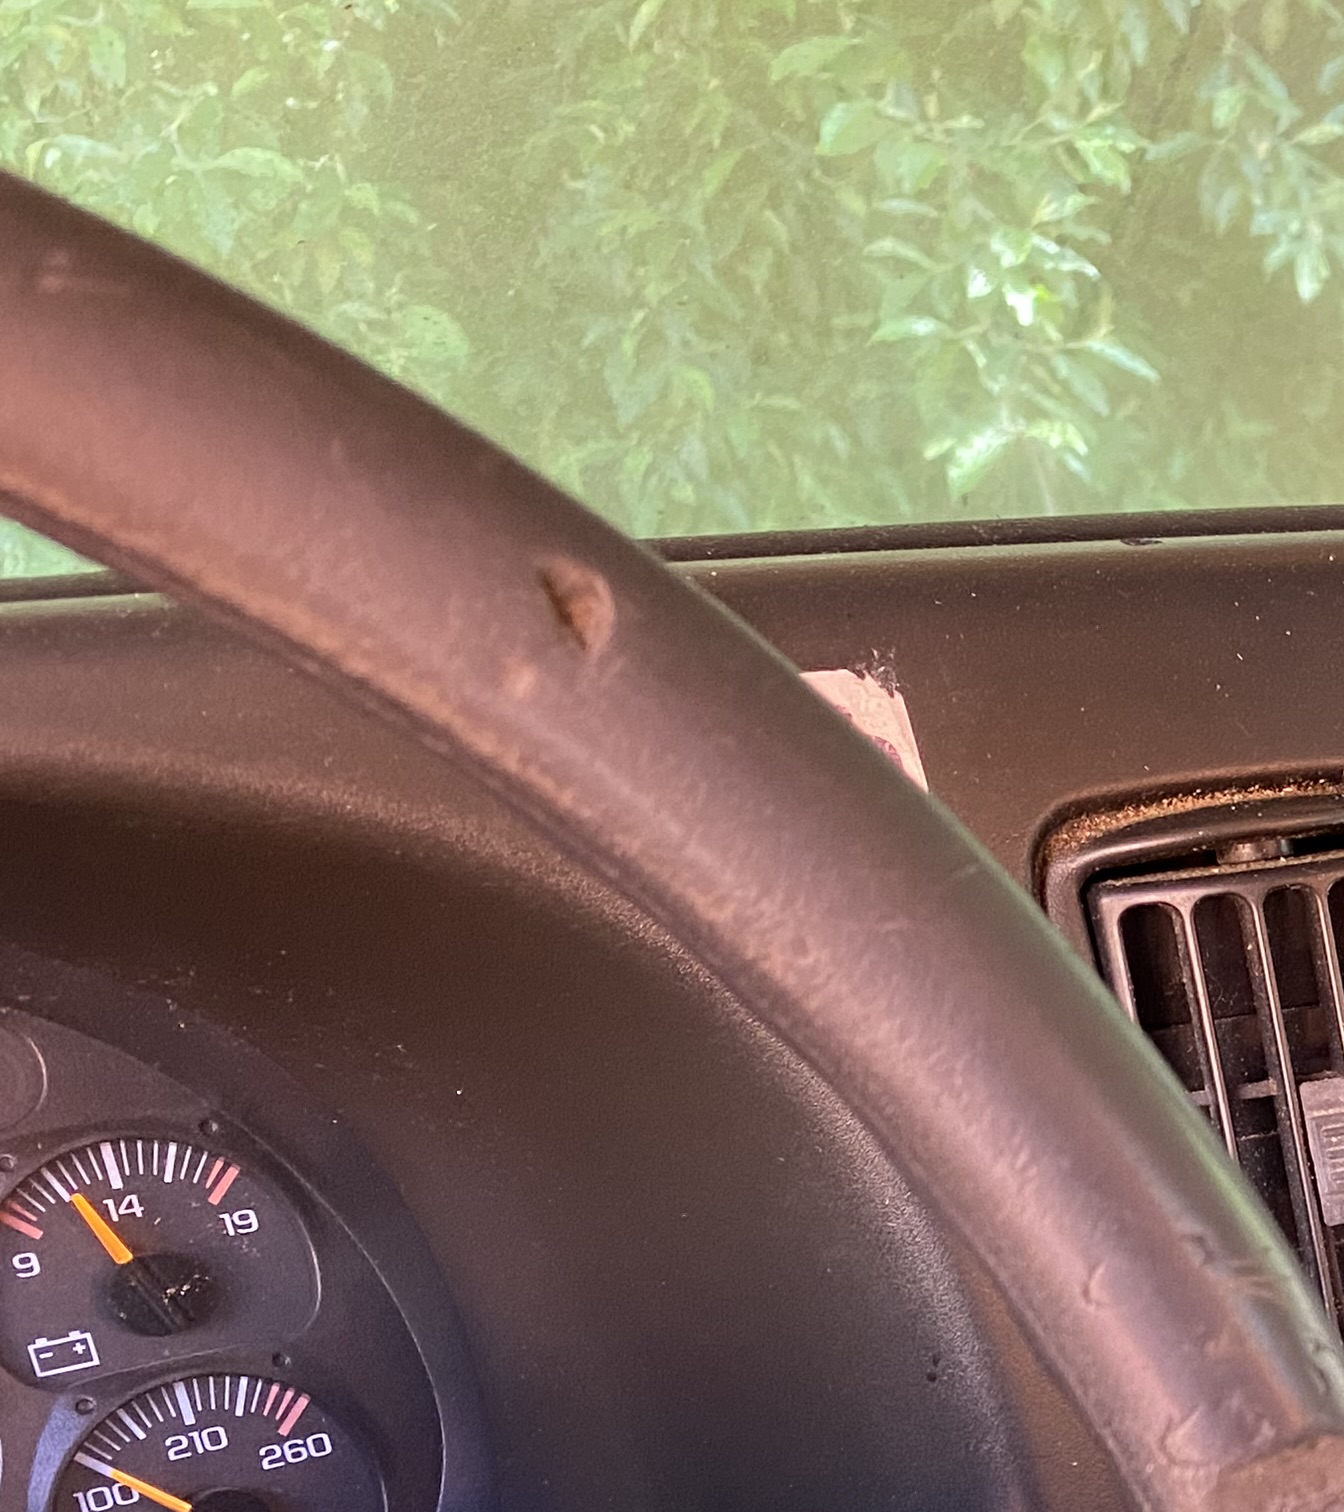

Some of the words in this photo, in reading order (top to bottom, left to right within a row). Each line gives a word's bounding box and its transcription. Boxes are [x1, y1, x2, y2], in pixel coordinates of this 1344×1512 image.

[104, 1193, 145, 1222] 14
[218, 1210, 259, 1236] 19
[11, 1253, 42, 1279] 9
[165, 1426, 228, 1461] 210
[259, 1433, 333, 1470] 260
